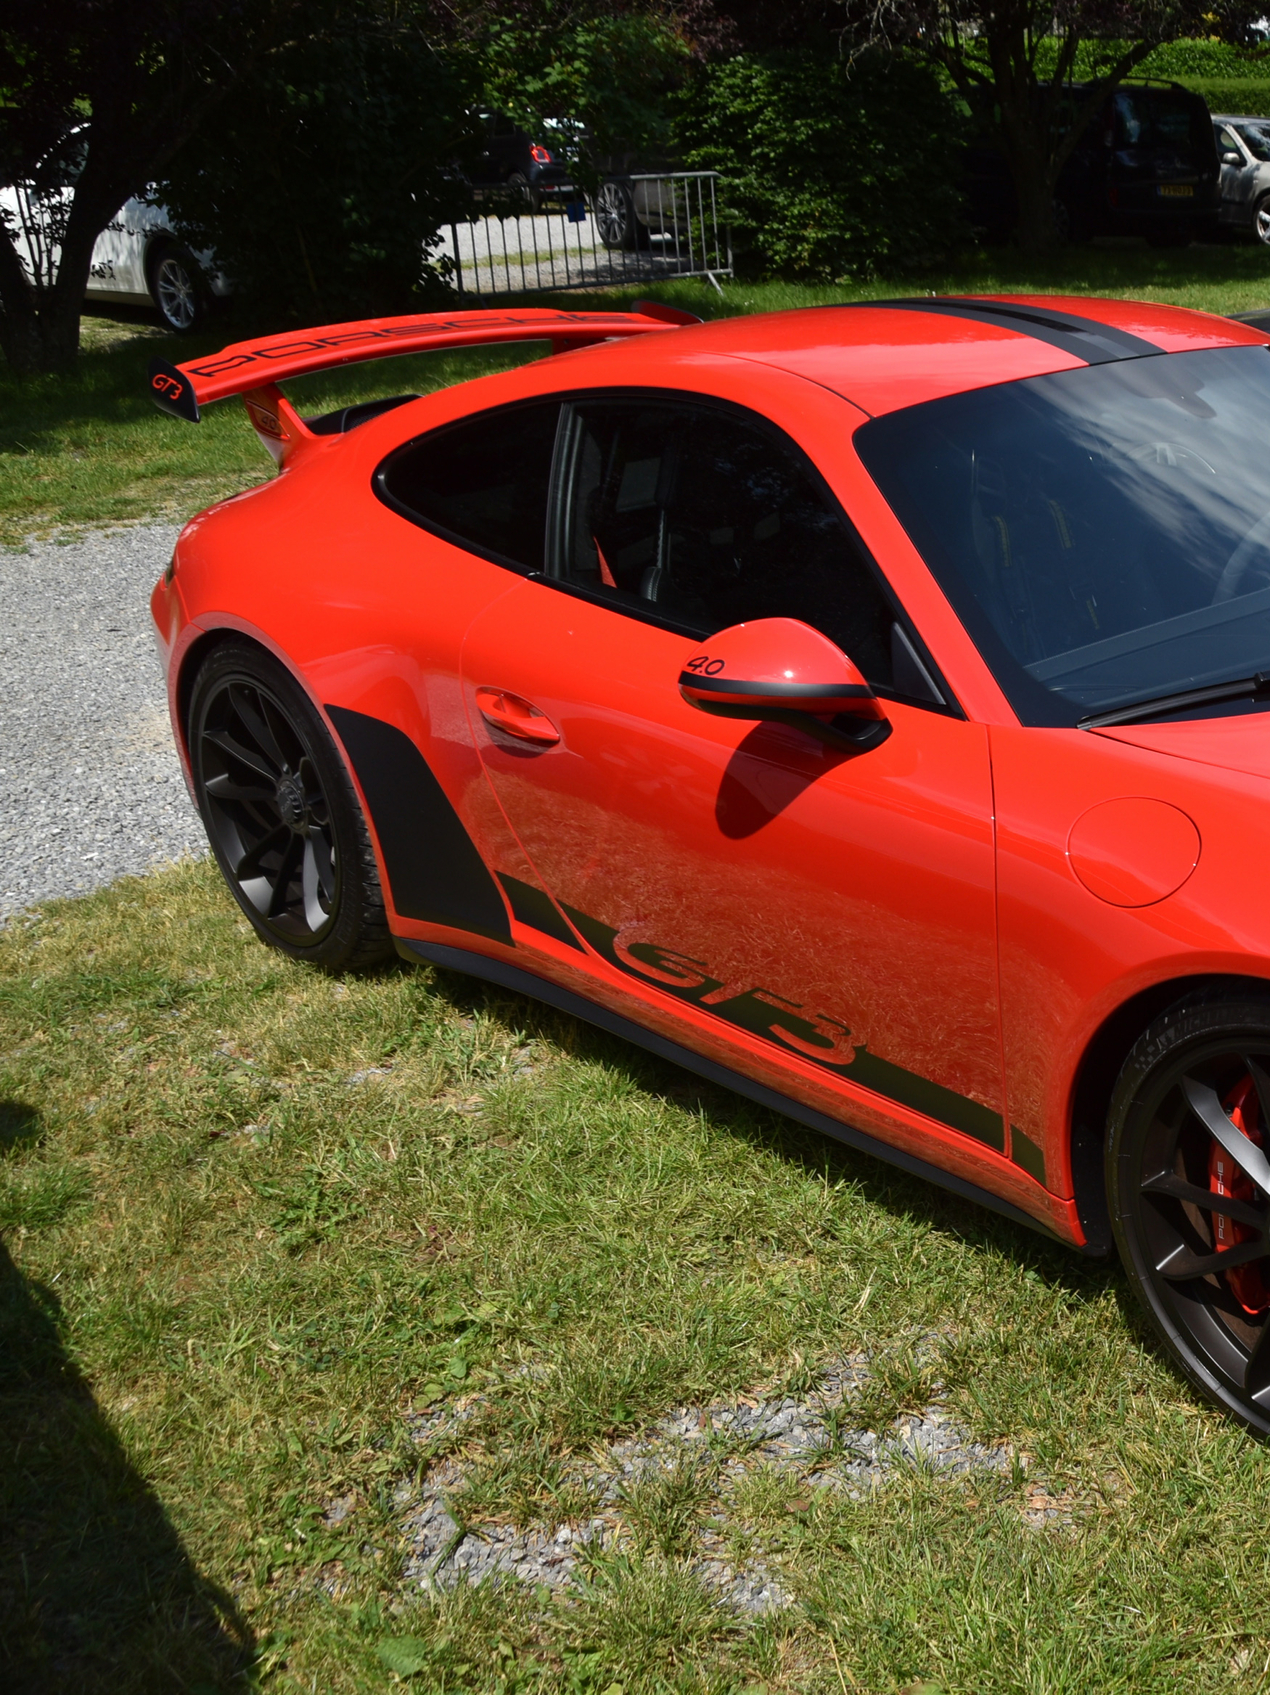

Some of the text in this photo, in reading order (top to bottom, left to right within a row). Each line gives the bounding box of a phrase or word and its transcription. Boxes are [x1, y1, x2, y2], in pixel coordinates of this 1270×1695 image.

[187, 315, 634, 377] PORSCHE
[152, 374, 183, 400] GT3
[687, 656, 725, 675] 4.0
[613, 930, 858, 1066] GT3
[1217, 1161, 1225, 1240] POCHE
